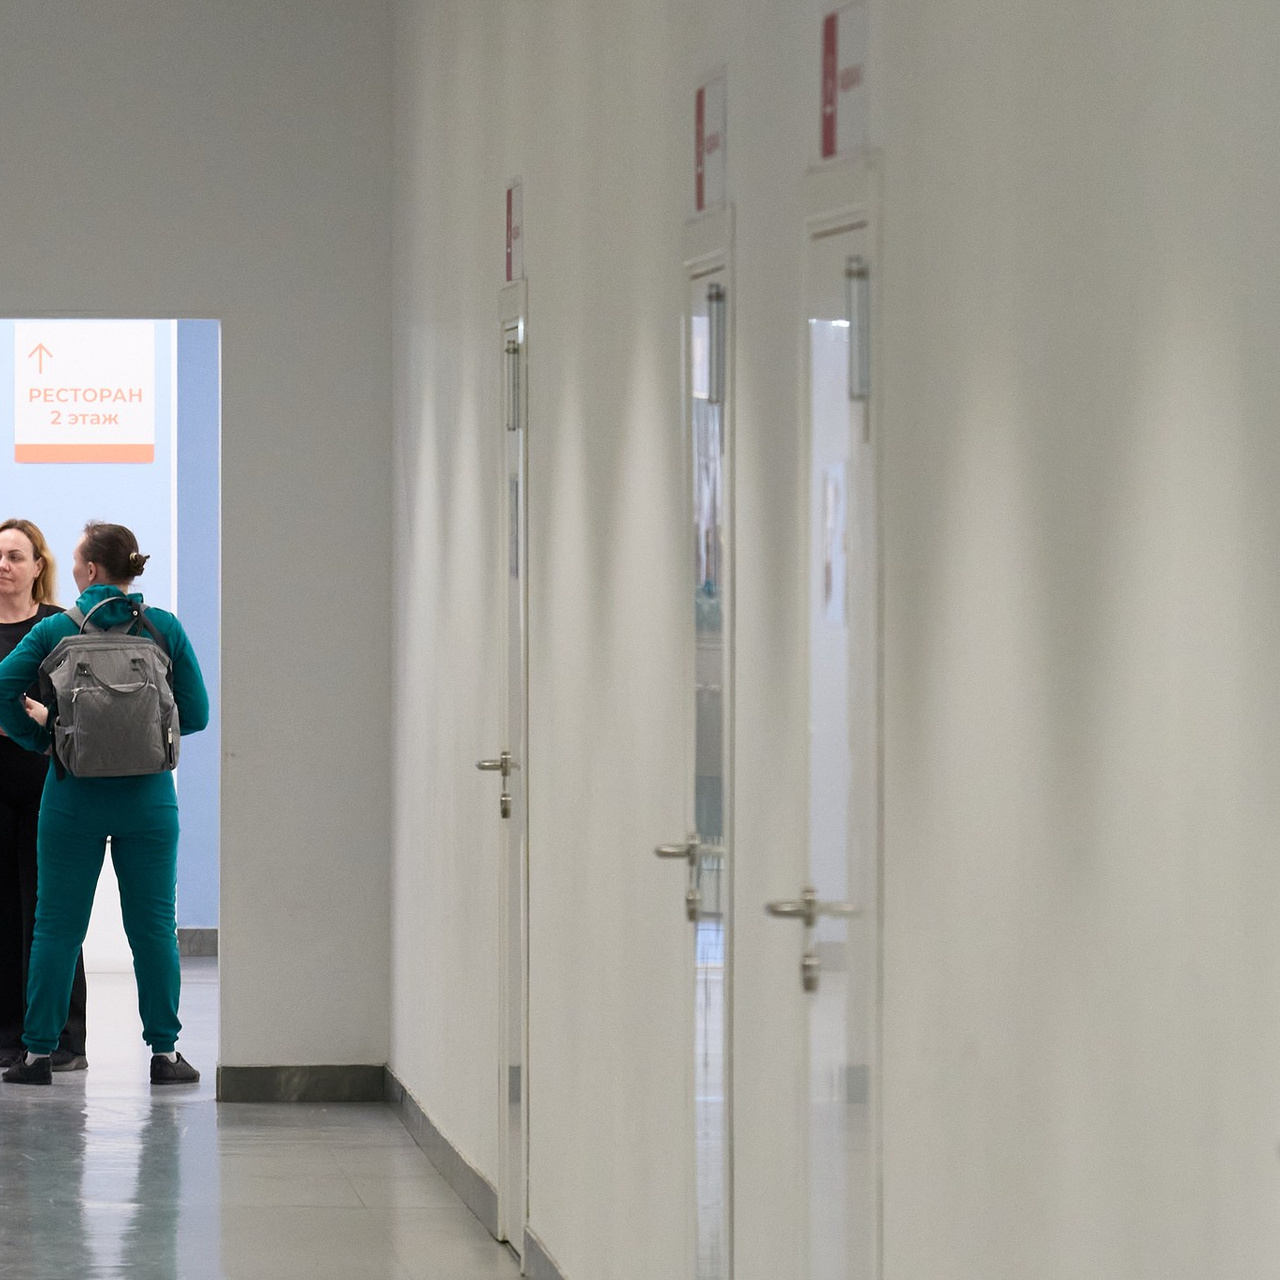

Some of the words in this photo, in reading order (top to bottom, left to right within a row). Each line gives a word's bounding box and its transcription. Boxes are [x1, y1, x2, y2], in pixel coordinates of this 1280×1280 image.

[29, 388, 143, 402] РЕСТОРАН
[50, 410, 62, 425] 2
[68, 413, 119, 425] этаж
